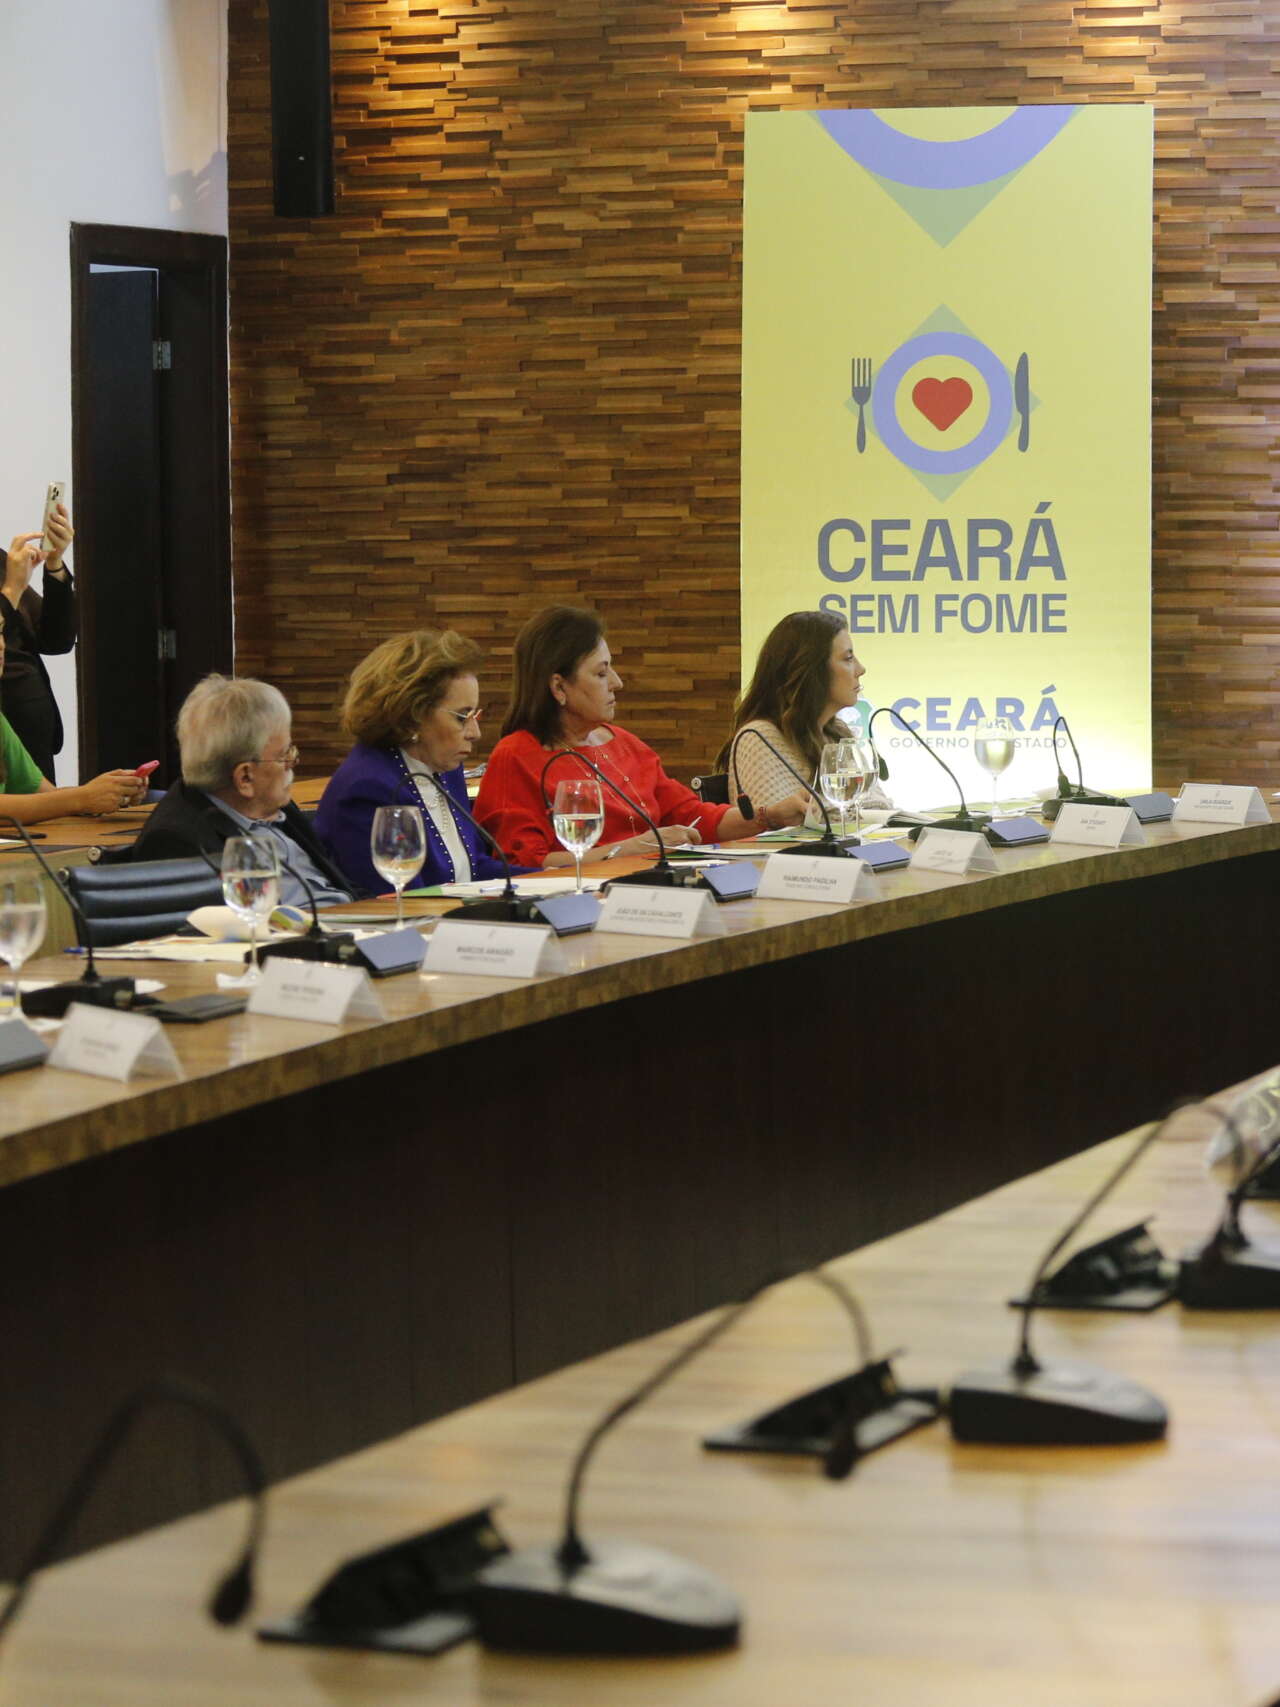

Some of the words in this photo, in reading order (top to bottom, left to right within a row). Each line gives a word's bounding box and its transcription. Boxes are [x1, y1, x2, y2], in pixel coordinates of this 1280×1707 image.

[818, 501, 1067, 582] CEARÁ
[819, 593, 919, 633] SEM
[934, 592, 1067, 633] FOME
[890, 684, 1067, 731] CEARÁ
[889, 737, 969, 749] GOVERNO
[1013, 737, 1067, 749] STADO
